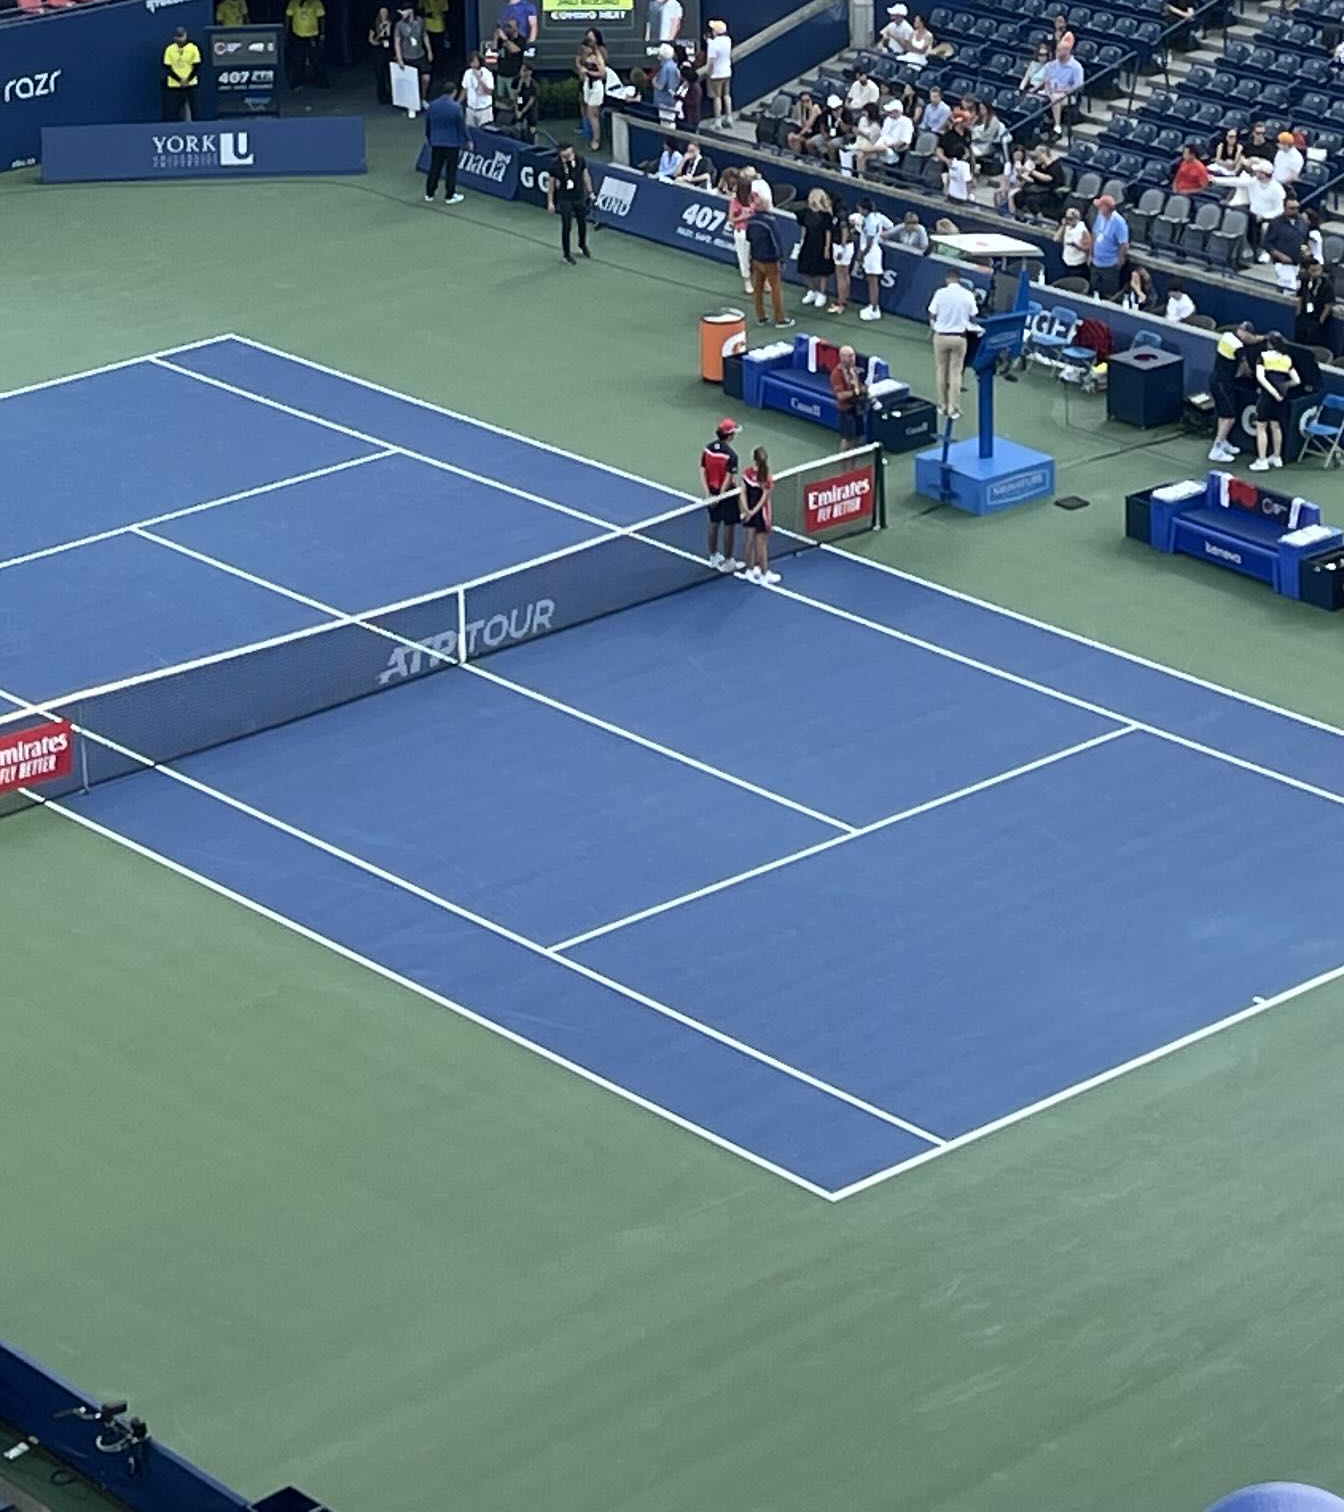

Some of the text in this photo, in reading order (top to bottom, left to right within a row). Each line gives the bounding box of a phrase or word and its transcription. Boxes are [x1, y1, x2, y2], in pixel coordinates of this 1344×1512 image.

[3, 70, 61, 102] razr
[218, 71, 249, 84] 407
[152, 134, 216, 153] YORK
[520, 167, 534, 189] G
[595, 193, 631, 217] KIND
[683, 203, 726, 231] 407
[808, 478, 870, 510] Emirates
[817, 496, 862, 523] FLY BETTER
[1205, 541, 1242, 564] beneva
[376, 598, 555, 685] ATP TOUR
[19, 754, 57, 779] BETTER
